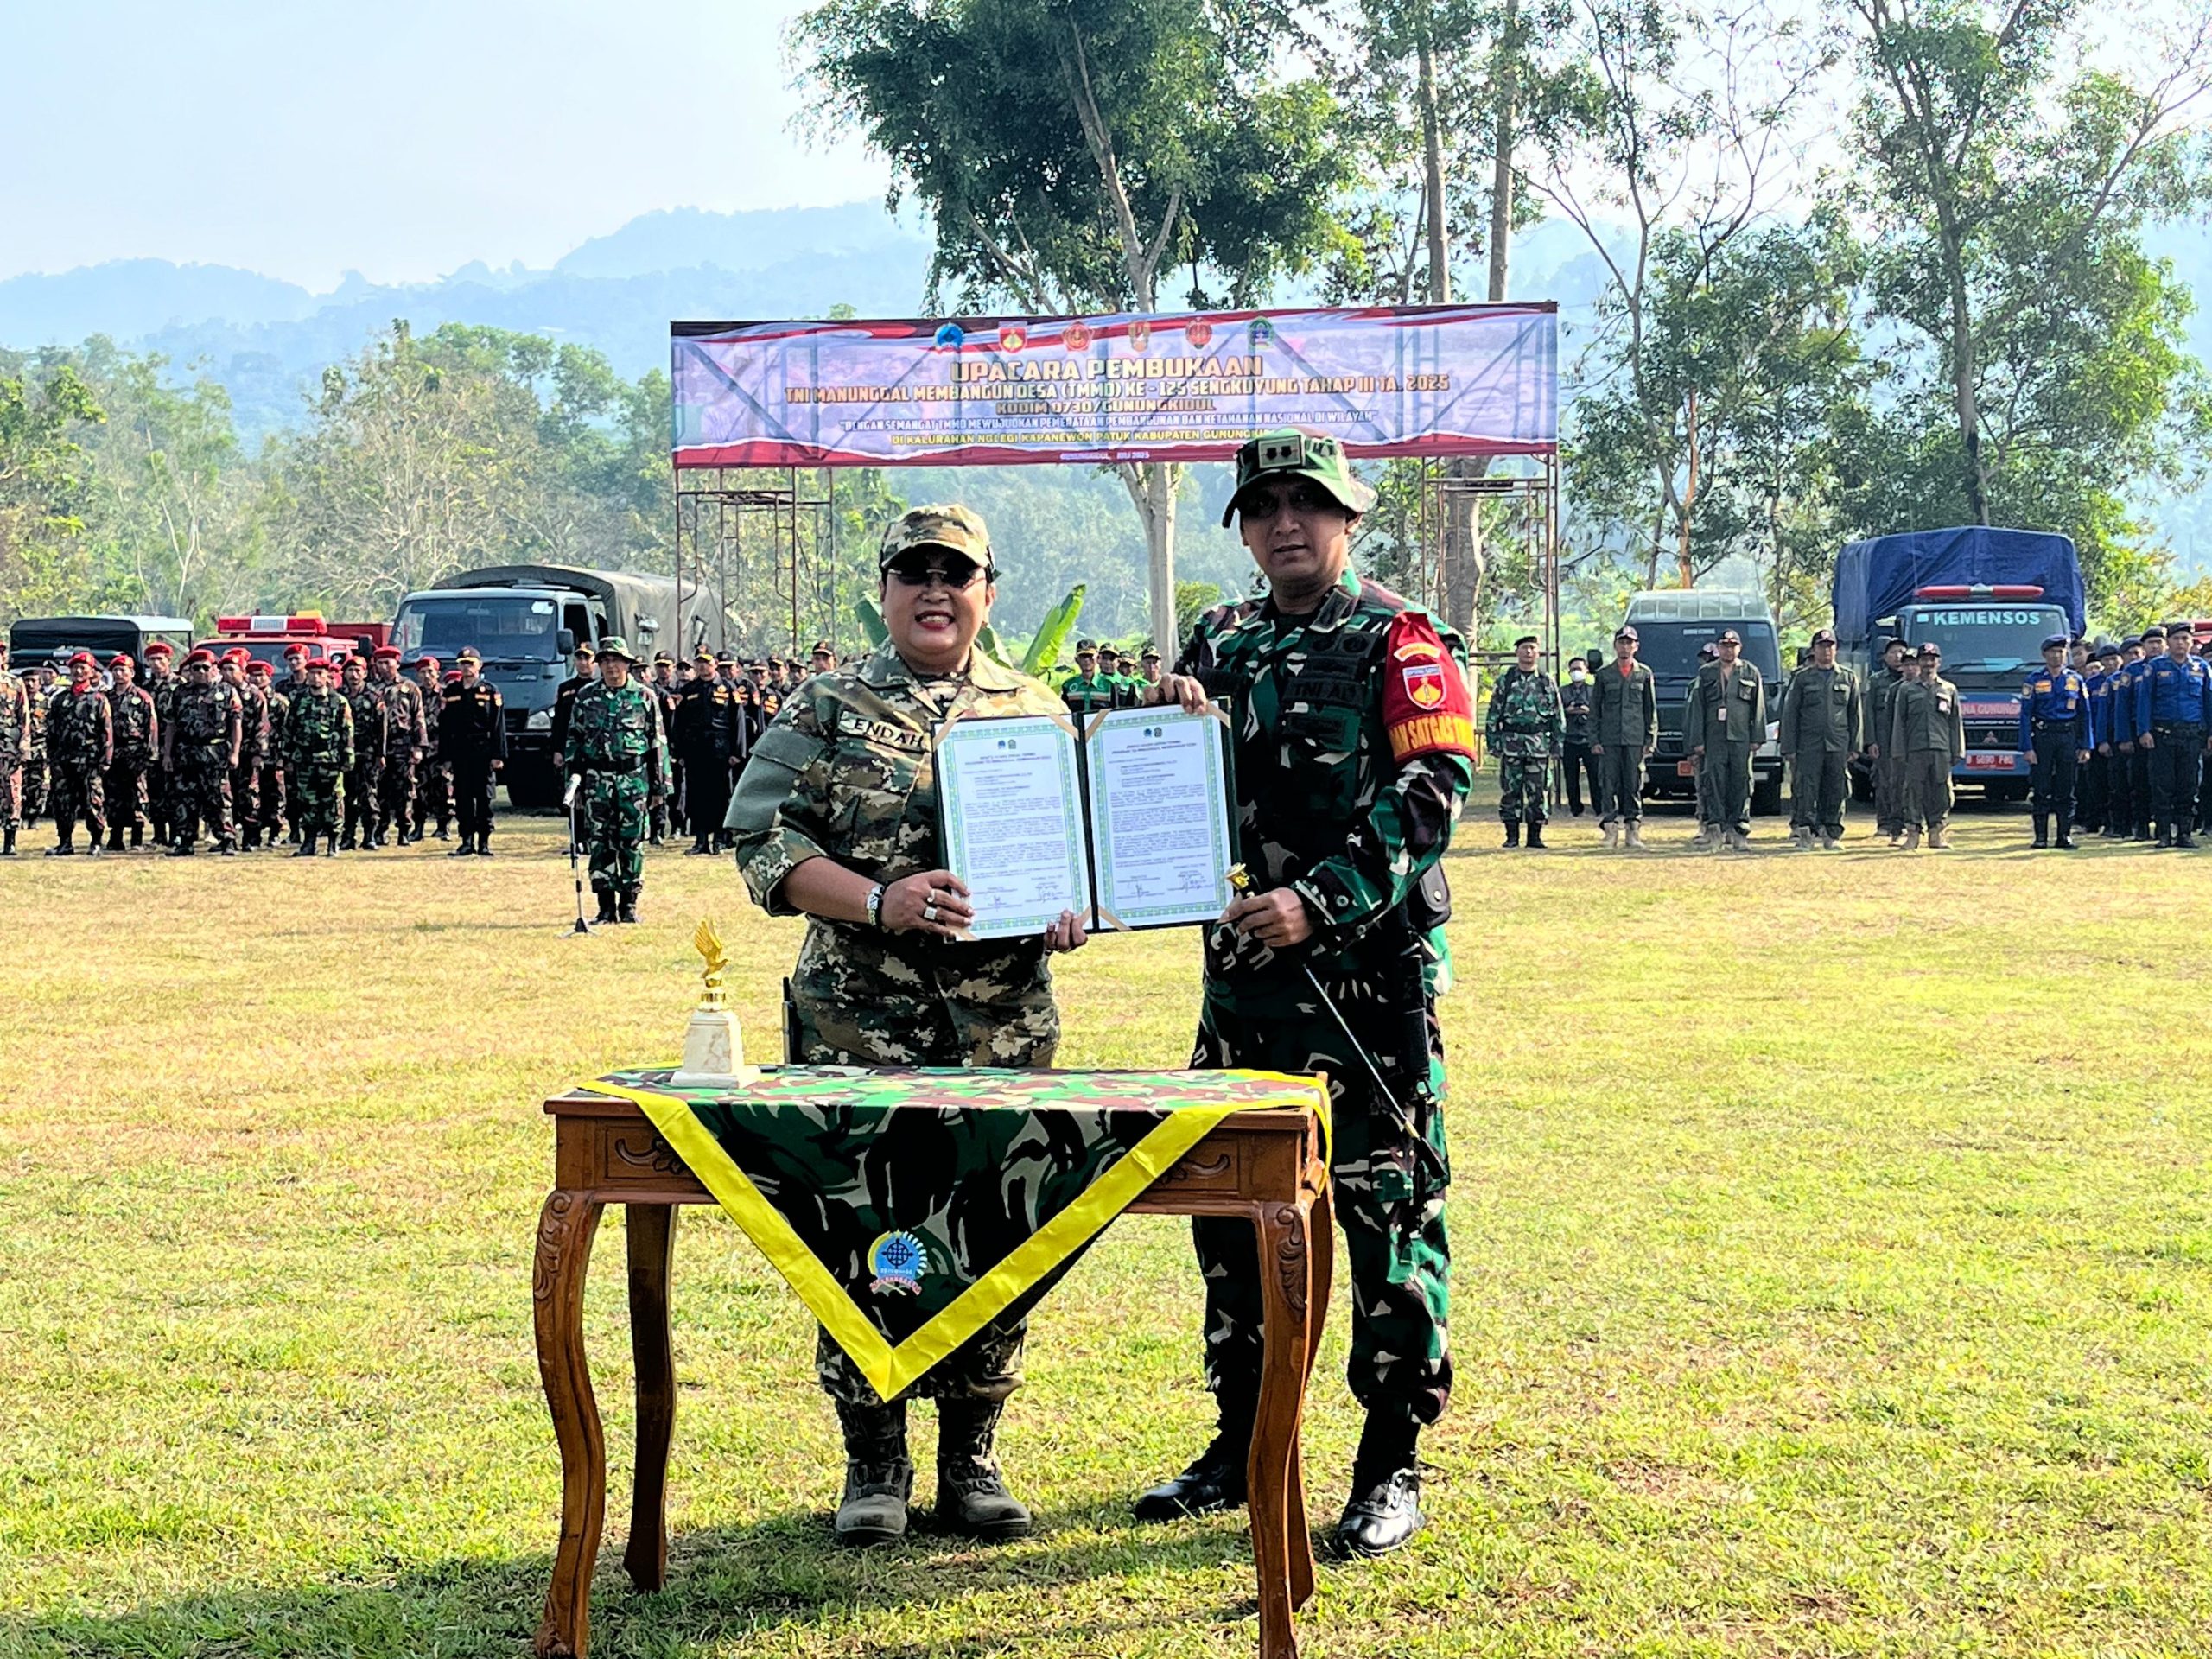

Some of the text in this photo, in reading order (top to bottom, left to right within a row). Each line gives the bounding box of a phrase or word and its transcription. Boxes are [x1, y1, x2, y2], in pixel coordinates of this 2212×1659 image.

[950, 355, 1263, 383] UPACARA PEMBUKAAN
[785, 387, 810, 403] TNI
[813, 385, 910, 403] MANUNGGAL
[913, 384, 1014, 402] MEMBANGUN
[1015, 382, 1057, 400] DESA
[1060, 381, 1122, 399] (TMMD)
[1125, 380, 1146, 397] KE
[1158, 380, 1188, 397] 125
[1191, 377, 1299, 397] SENGKUYUNG
[1302, 375, 1356, 394] TAHAP
[1357, 375, 1376, 393] III
[1405, 372, 1451, 391] 2025
[995, 397, 1217, 416] KODIM 0730/GUNUNGKIDUL
[885, 418, 936, 431] SEMANGAT
[968, 416, 1037, 429] MEWUJUDKAN
[1039, 415, 1103, 429] PEMERATAAN
[1181, 414, 1202, 426] DAN
[1204, 412, 1262, 425] KETAHANAN
[1264, 411, 1312, 423] NASIONAL
[1314, 410, 1325, 423] DI
[891, 434, 904, 445] DI
[906, 433, 975, 445] KALURAHAN
[977, 432, 1018, 444] NGLEGI
[1020, 430, 1093, 443] KAPANEWON
[1096, 430, 1130, 442] PATUK
[1134, 429, 1200, 442] KABUPATEN
[1934, 610, 2040, 626] KEMENSOS
[854, 717, 924, 747] ENDAH
[1408, 715, 1456, 750] SATGAS
